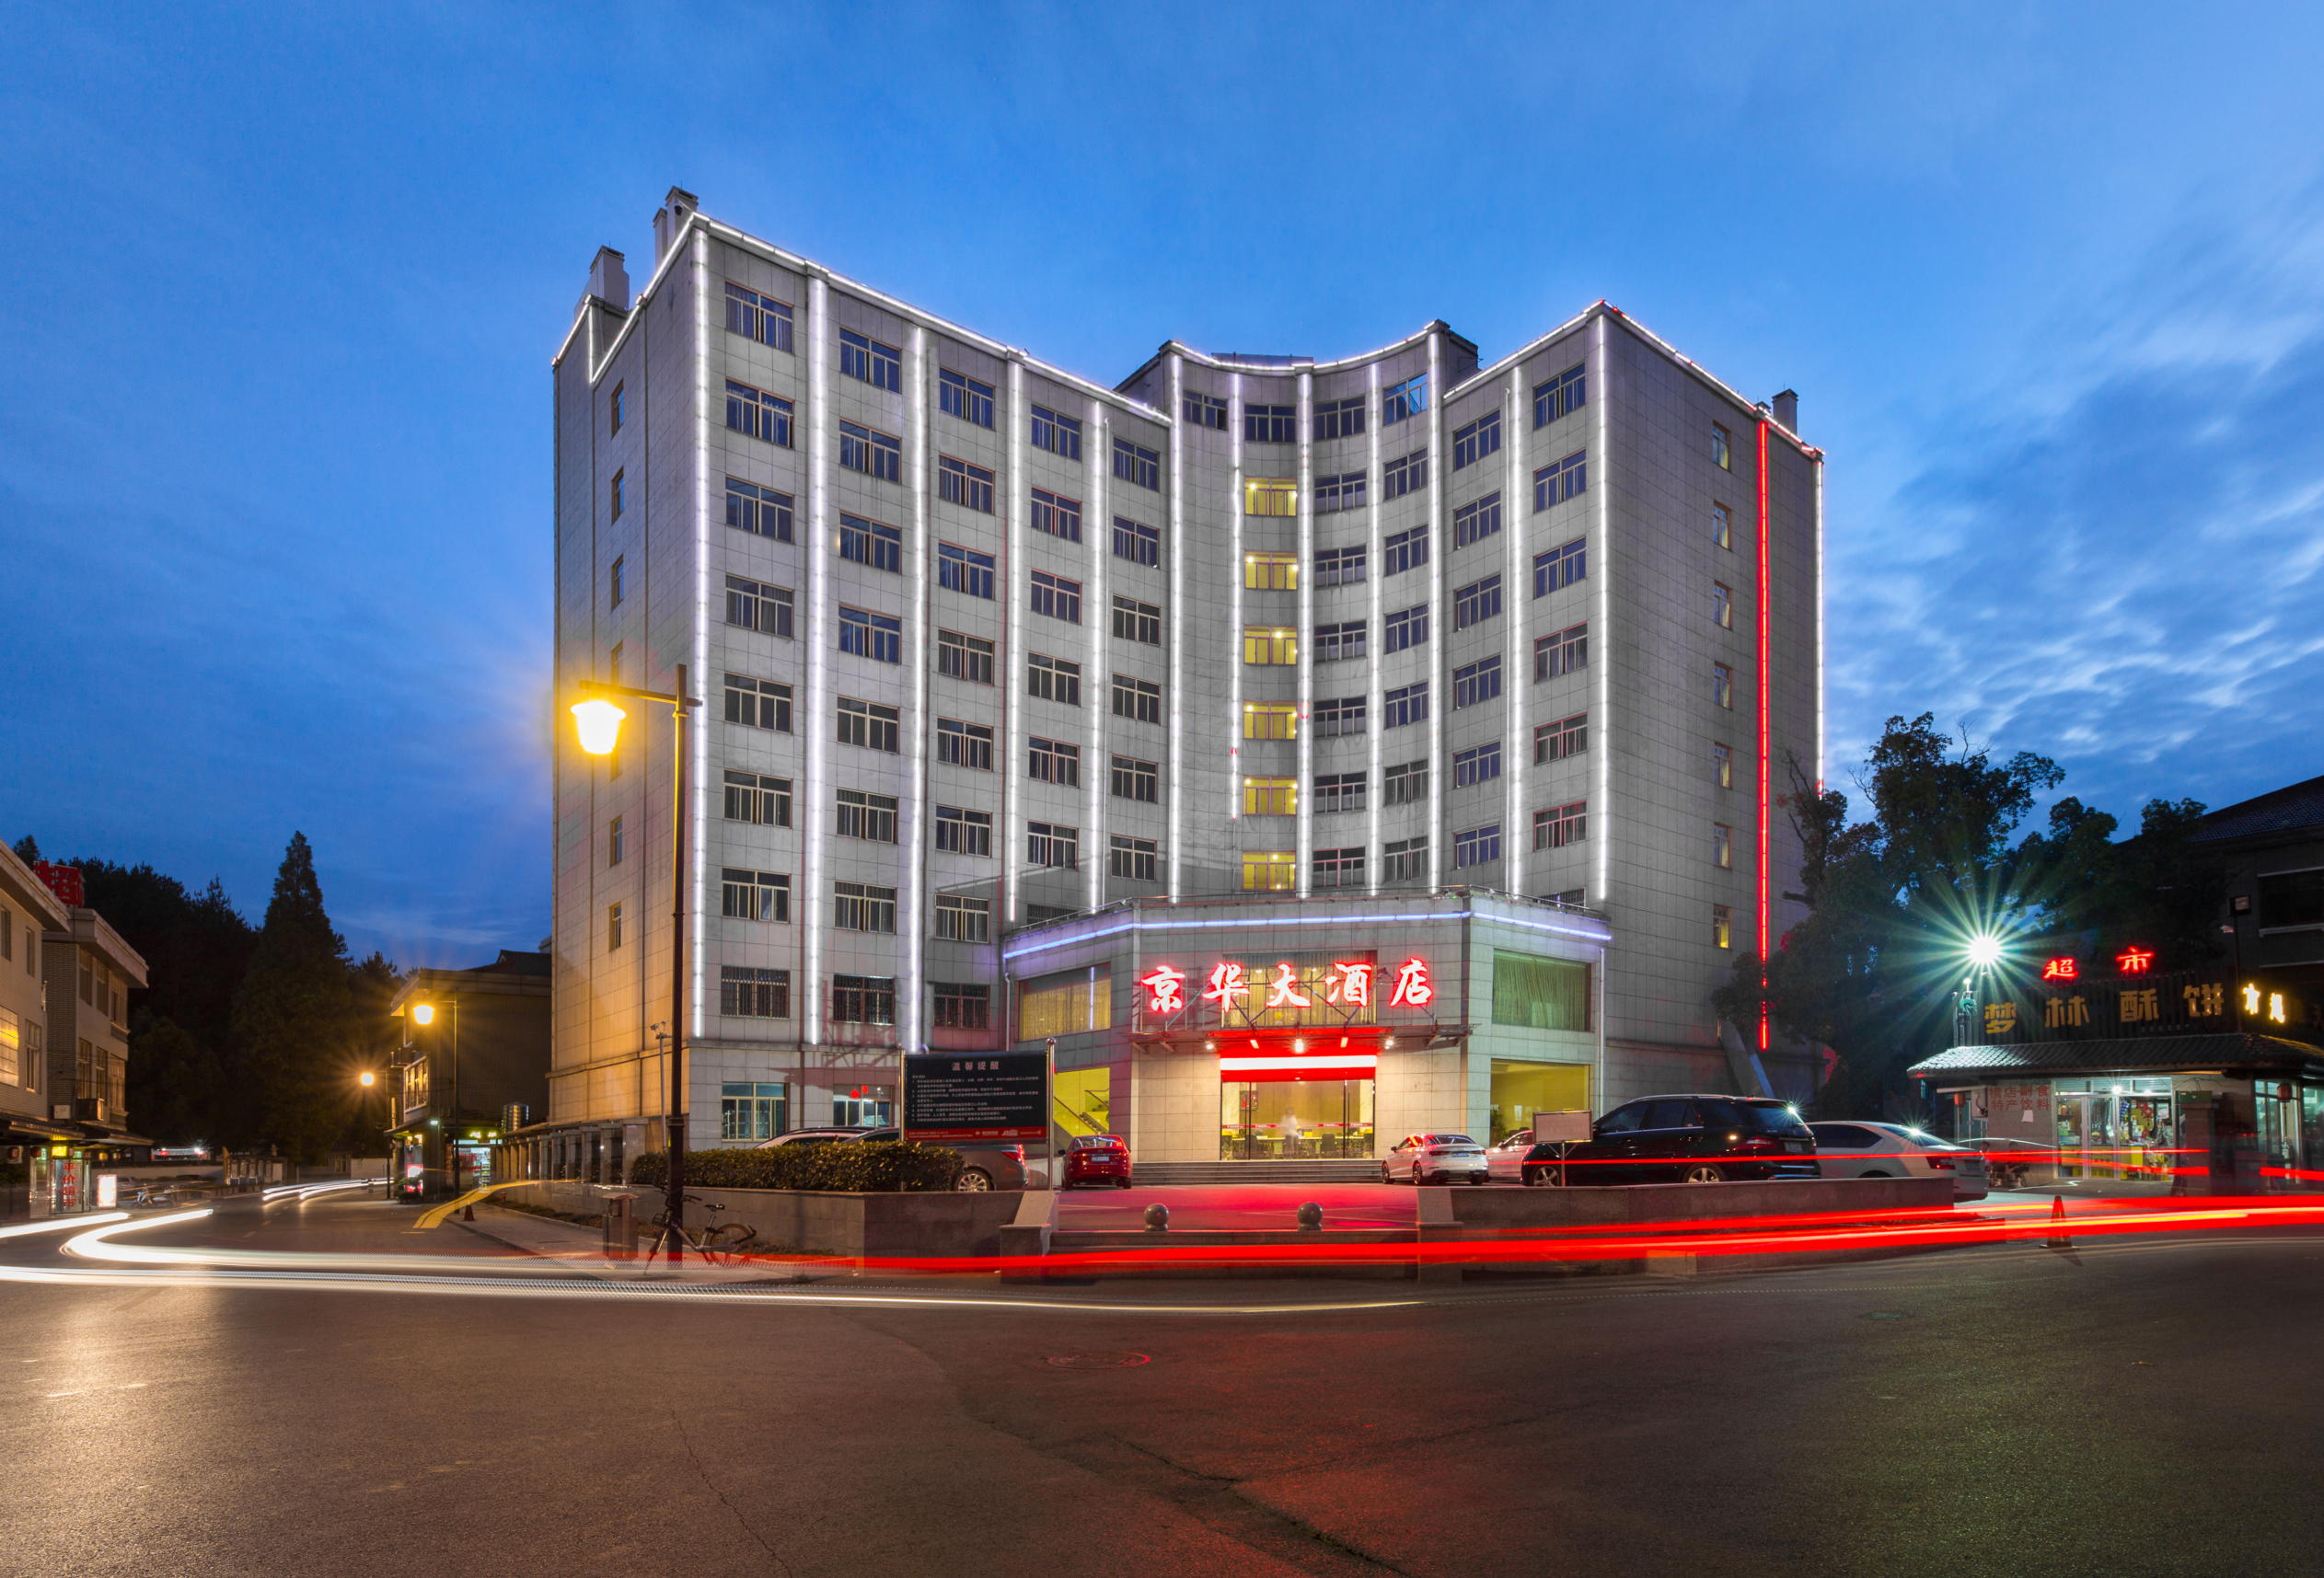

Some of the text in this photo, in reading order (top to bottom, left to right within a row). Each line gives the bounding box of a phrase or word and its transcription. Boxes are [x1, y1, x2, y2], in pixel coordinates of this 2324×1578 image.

[2042, 946, 2155, 980] 超市
[1141, 958, 1432, 1013] 京华大酒店
[1984, 983, 2224, 1034] 梦林酥饼
[952, 1061, 999, 1071] 温馨提醒
[1989, 1085, 2049, 1099] 横店副食
[1991, 1099, 2049, 1111] 特产饮料
[62, 1162, 77, 1208] 平价超市
